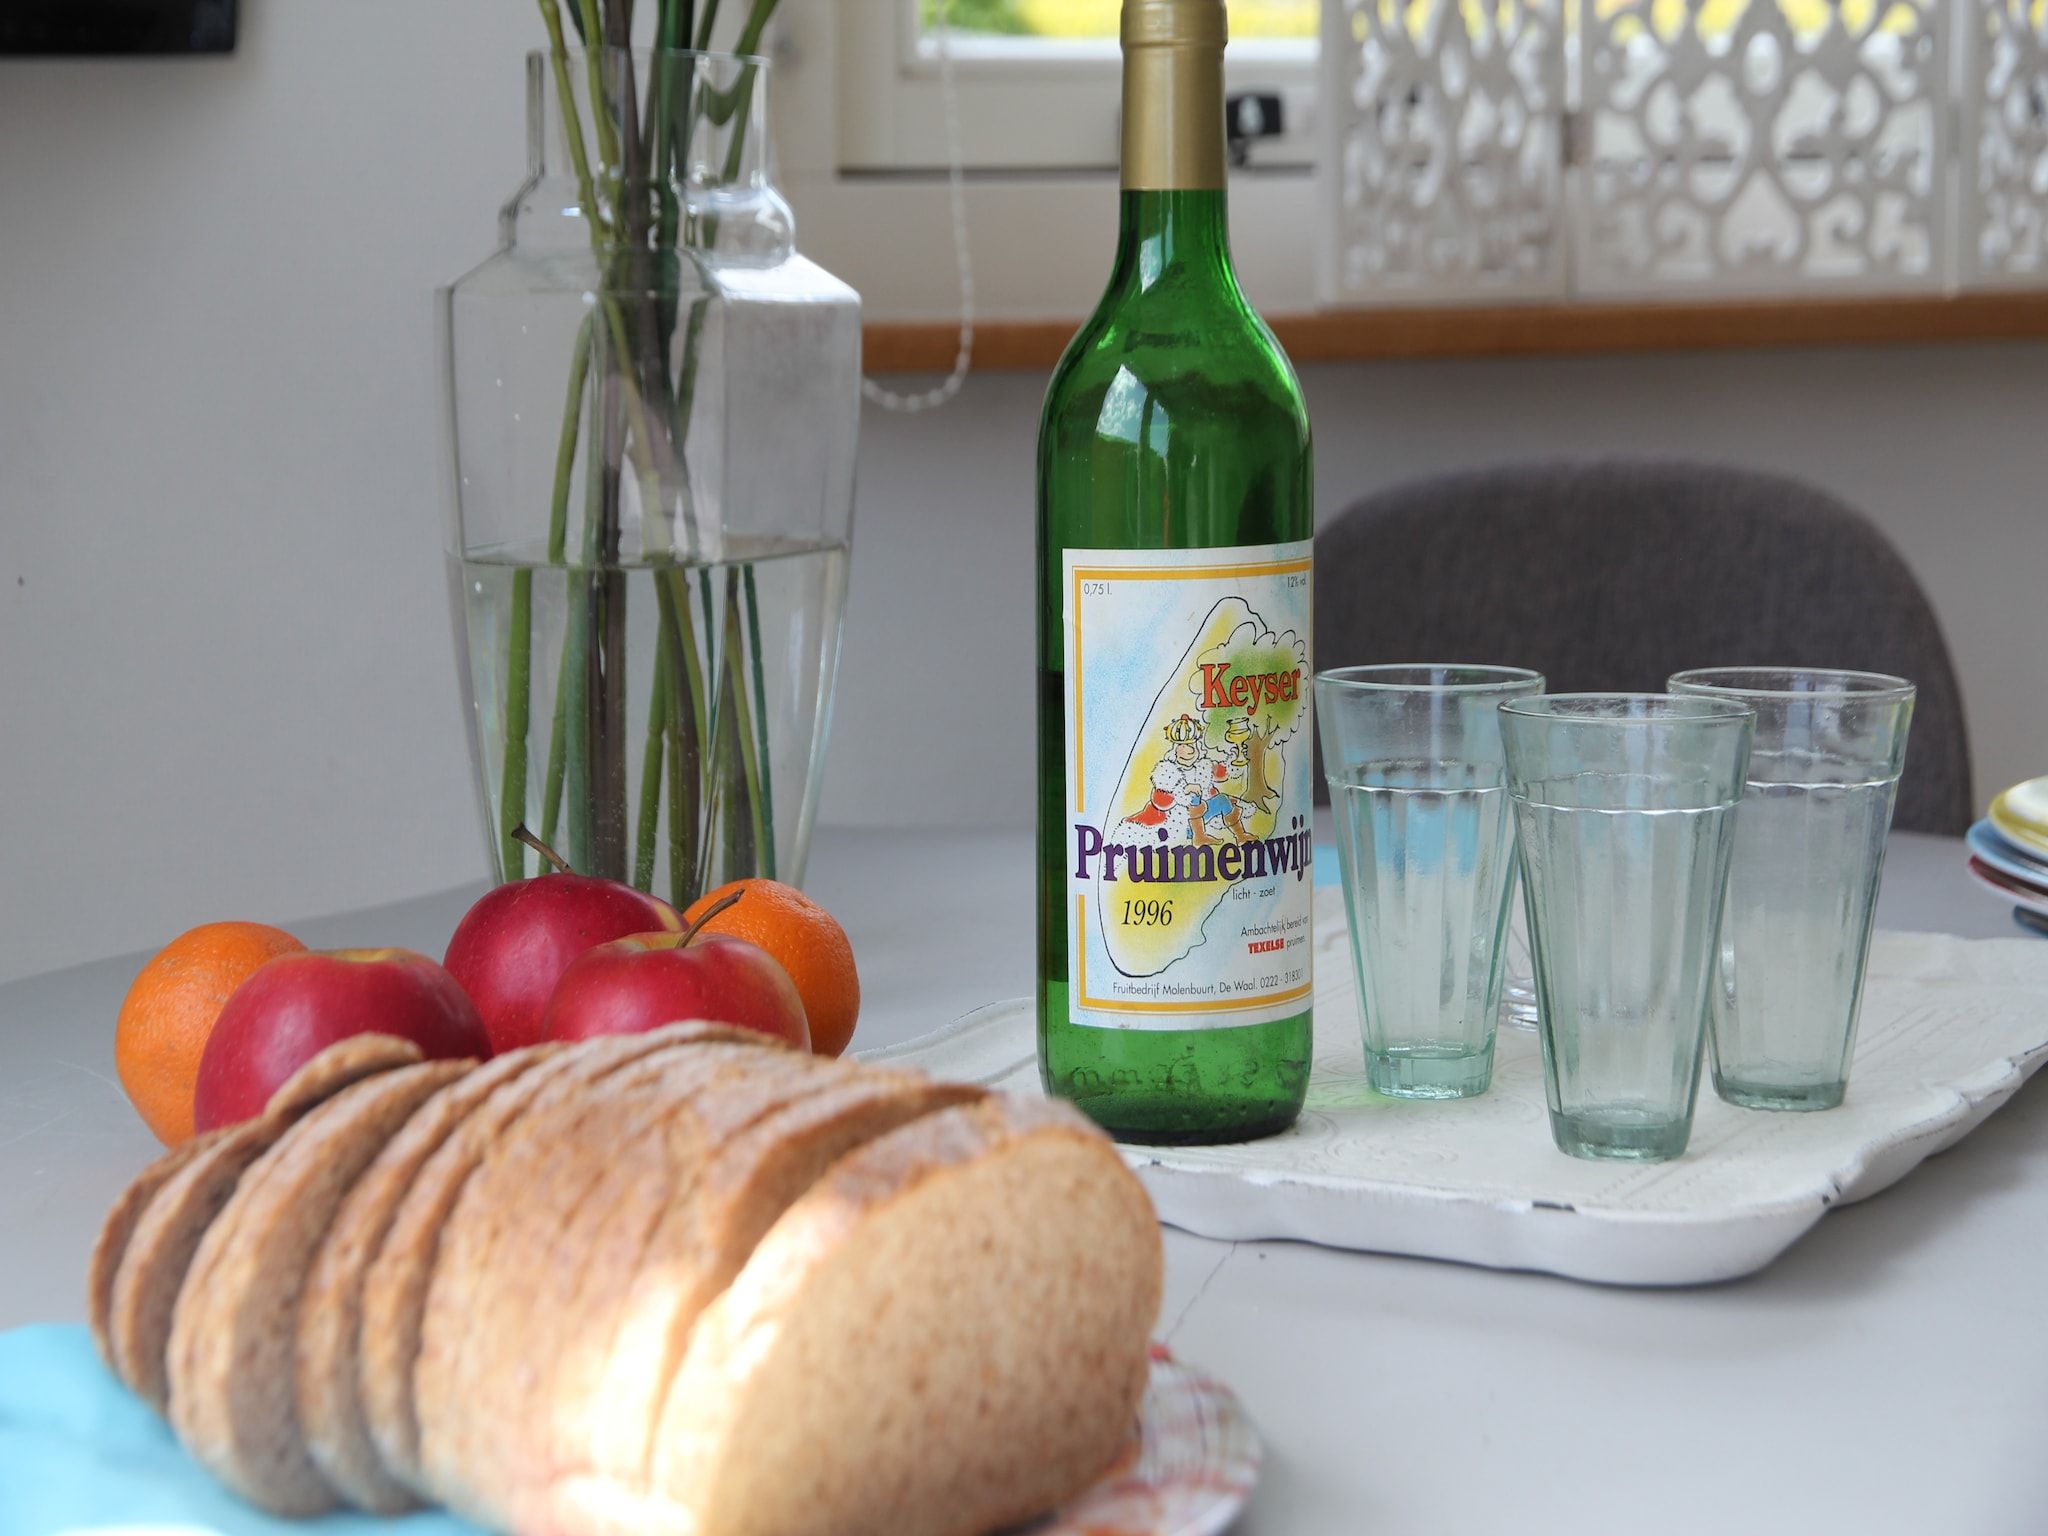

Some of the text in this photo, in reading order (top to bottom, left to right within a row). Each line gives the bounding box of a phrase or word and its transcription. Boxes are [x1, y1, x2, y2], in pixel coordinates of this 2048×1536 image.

[1083, 583, 1104, 597] 0,75
[1199, 662, 1301, 717] Keyser
[1074, 814, 1312, 884] Pruimenwijn
[1232, 887, 1251, 901] licht
[1259, 886, 1276, 898] zoet
[1121, 899, 1174, 927] 1996
[1240, 916, 1286, 937] Ambachtelijk
[1248, 938, 1285, 954] TEXELSE
[1113, 982, 1160, 998] Fruitbedrijf
[1219, 982, 1231, 993] De
[1260, 974, 1279, 989] 0222
